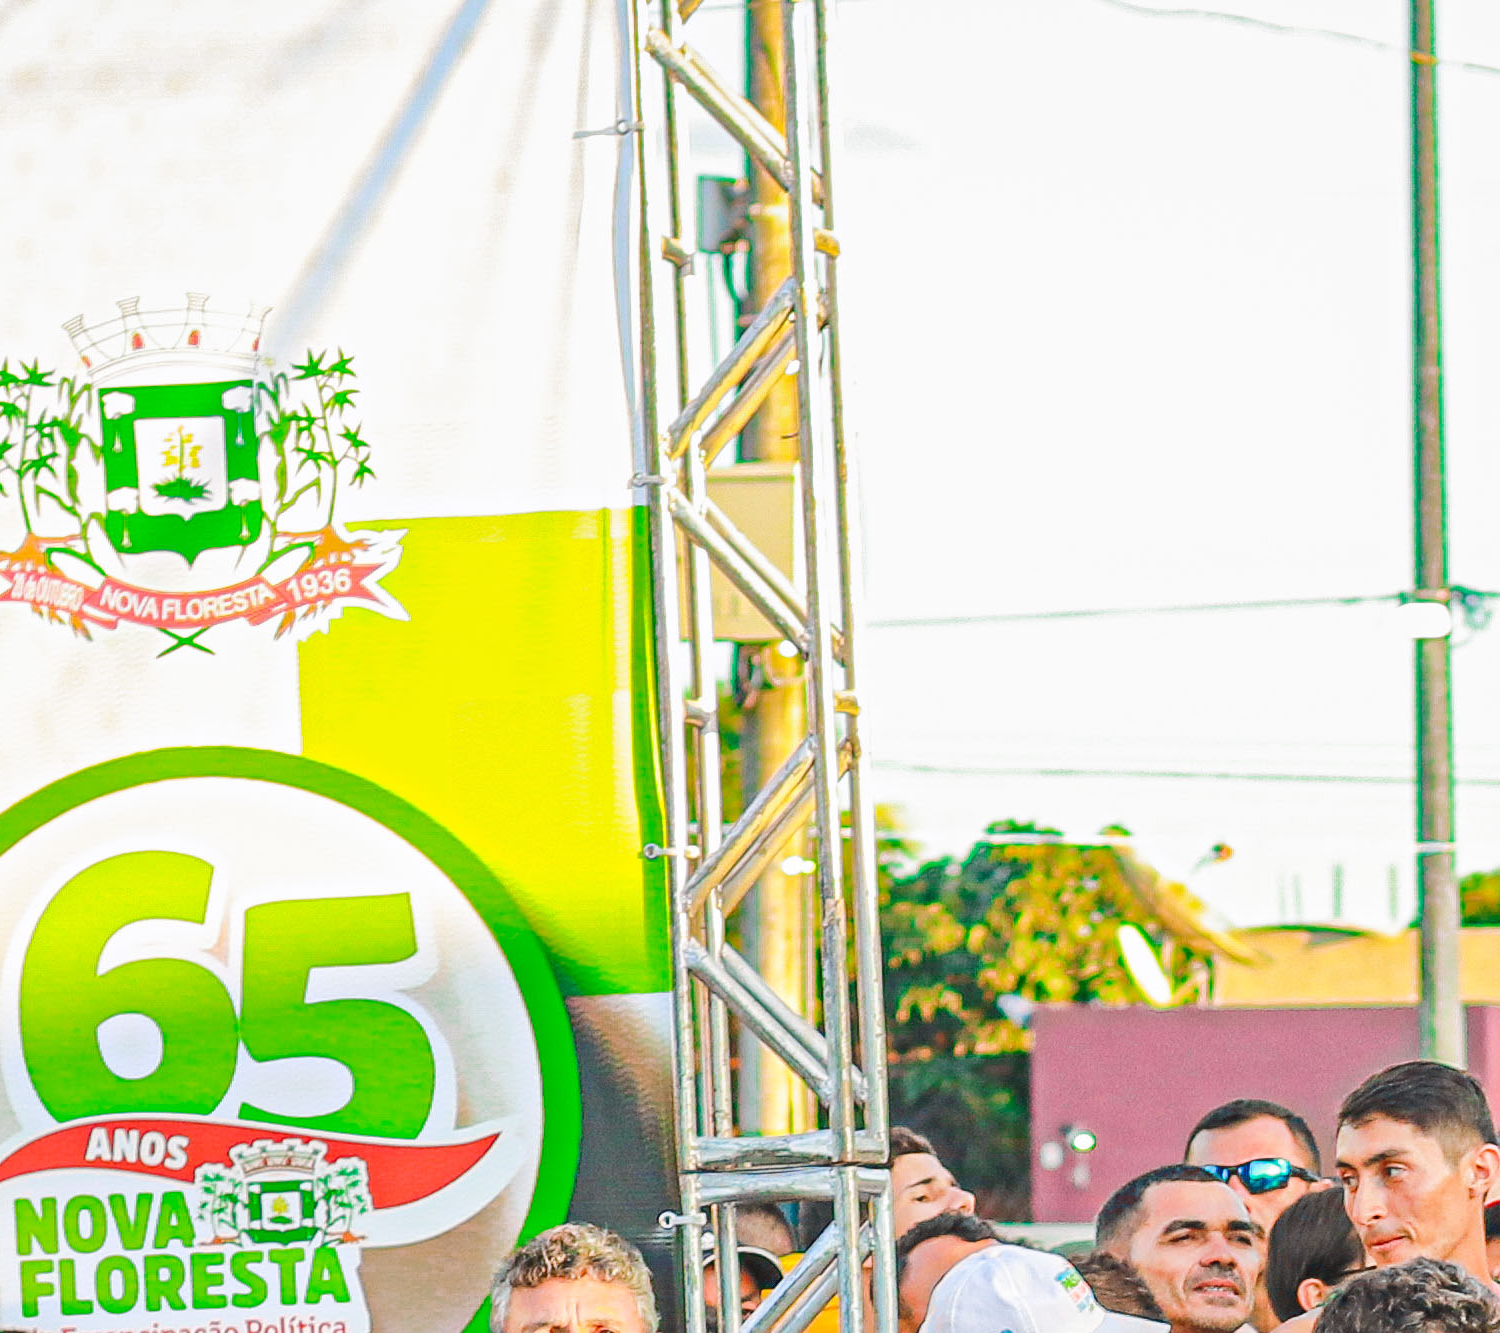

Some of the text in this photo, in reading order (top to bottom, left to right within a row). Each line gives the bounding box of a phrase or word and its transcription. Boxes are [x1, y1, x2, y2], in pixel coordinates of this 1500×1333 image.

[99, 582, 278, 622] NOVA FLORESTA
[285, 567, 353, 602] 1936
[18, 849, 437, 1140] 65
[84, 1126, 190, 1171] ANOS
[13, 1190, 197, 1256] NOVA
[19, 1246, 351, 1318] FLORESTA
